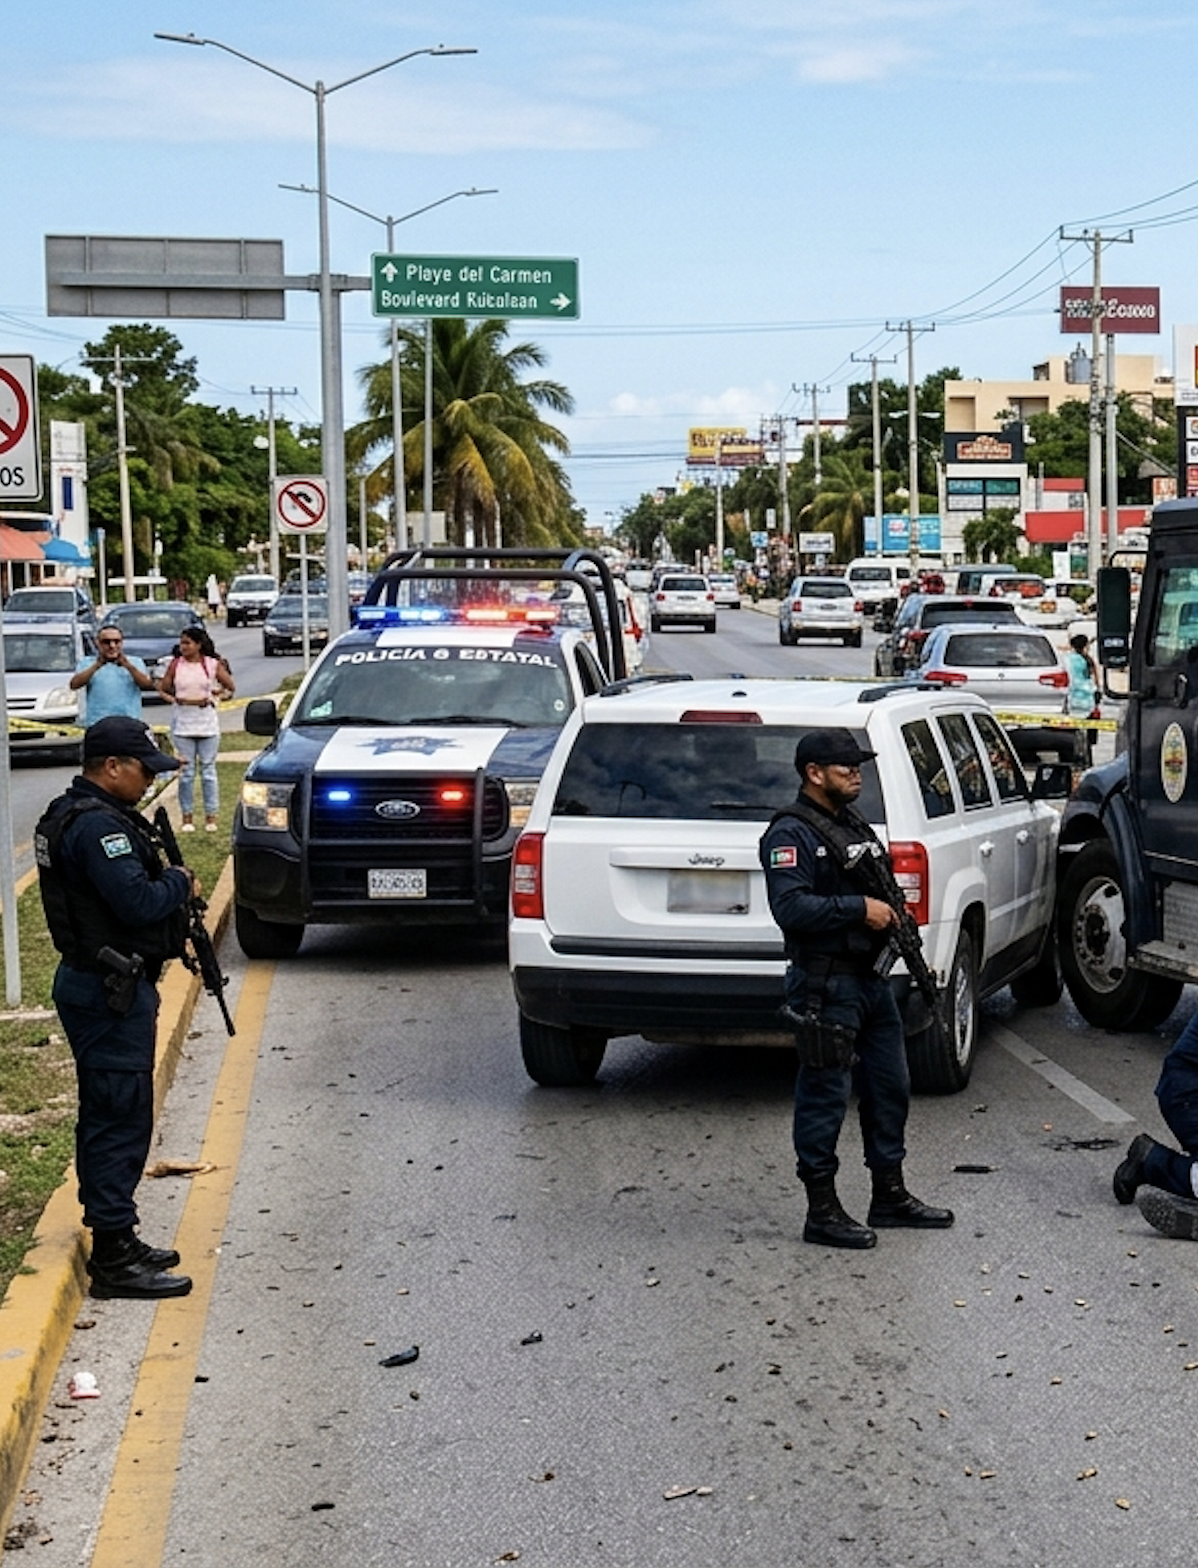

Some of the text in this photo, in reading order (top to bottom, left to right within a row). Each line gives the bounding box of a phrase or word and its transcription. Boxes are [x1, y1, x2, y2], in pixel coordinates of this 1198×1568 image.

[458, 266, 484, 283] del
[489, 265, 552, 284] Carmen
[381, 289, 460, 308] Boulevard
